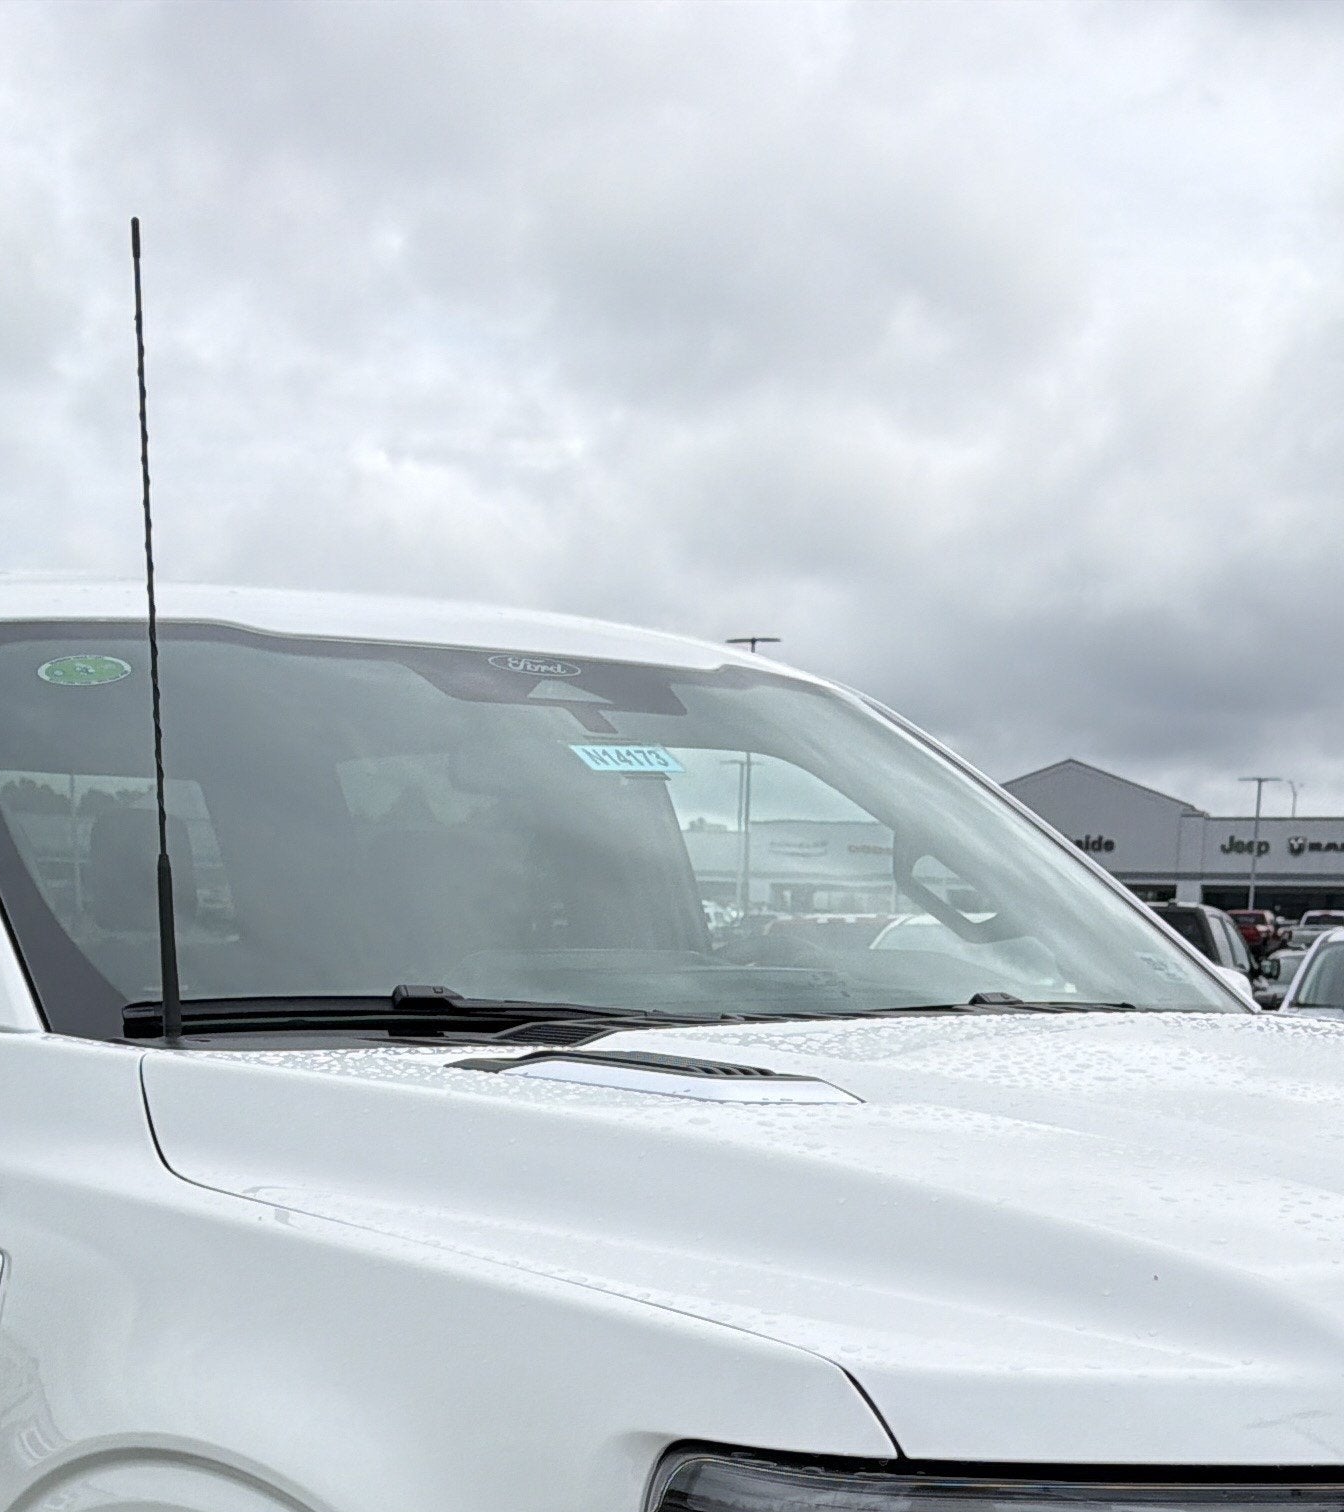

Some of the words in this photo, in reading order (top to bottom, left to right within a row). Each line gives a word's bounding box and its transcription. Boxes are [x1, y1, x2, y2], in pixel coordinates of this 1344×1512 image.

[508, 655, 567, 674] Ford
[581, 747, 670, 767] N14173
[1220, 835, 1271, 857] Jeep
